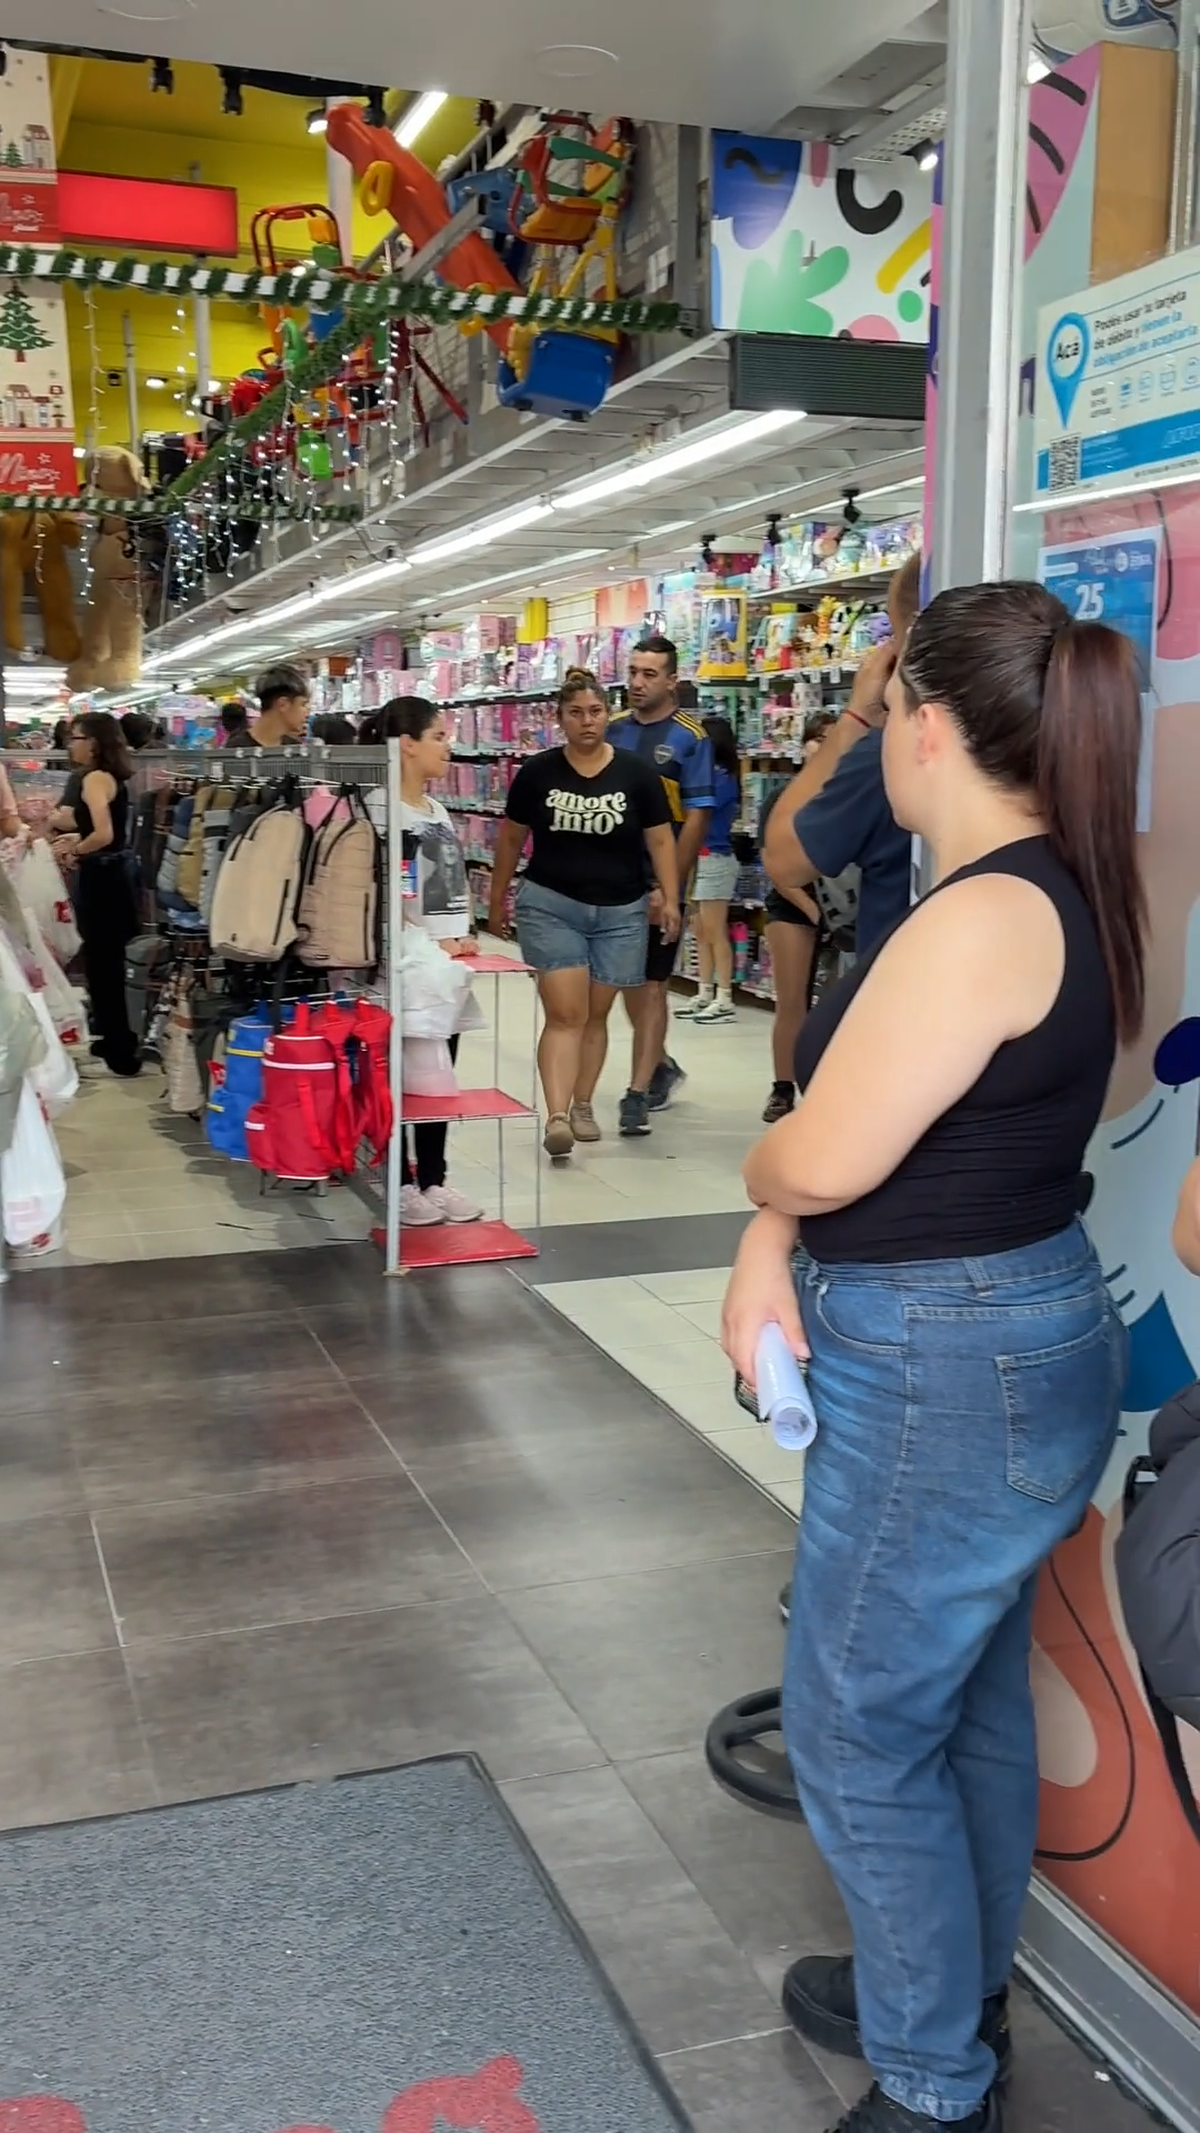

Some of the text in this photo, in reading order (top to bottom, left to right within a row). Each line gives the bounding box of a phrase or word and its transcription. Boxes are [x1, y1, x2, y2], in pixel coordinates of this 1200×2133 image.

[1074, 582, 1104, 620] 25
[545, 789, 627, 816] amore
[549, 808, 615, 835] mio
